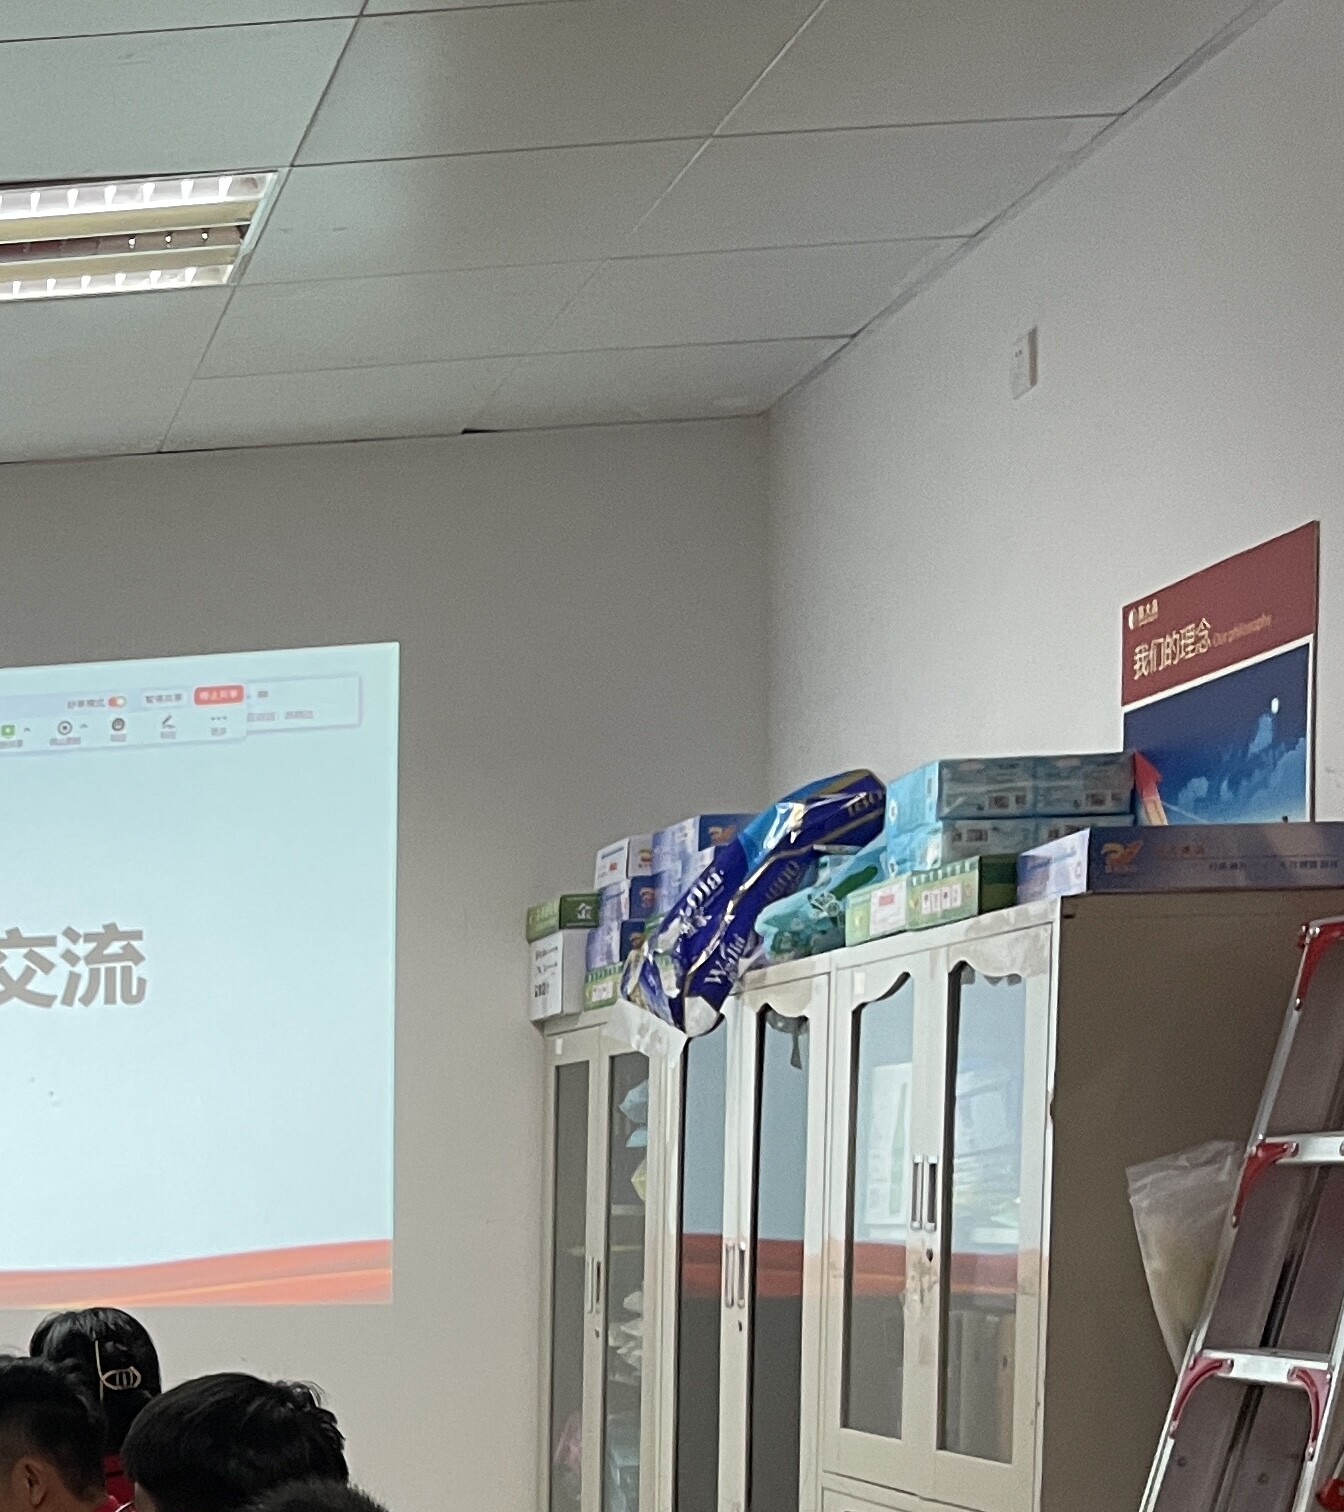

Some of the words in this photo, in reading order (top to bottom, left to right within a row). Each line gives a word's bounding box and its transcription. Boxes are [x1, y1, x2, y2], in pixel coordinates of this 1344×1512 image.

[1133, 617, 1212, 681] 我们的理念
